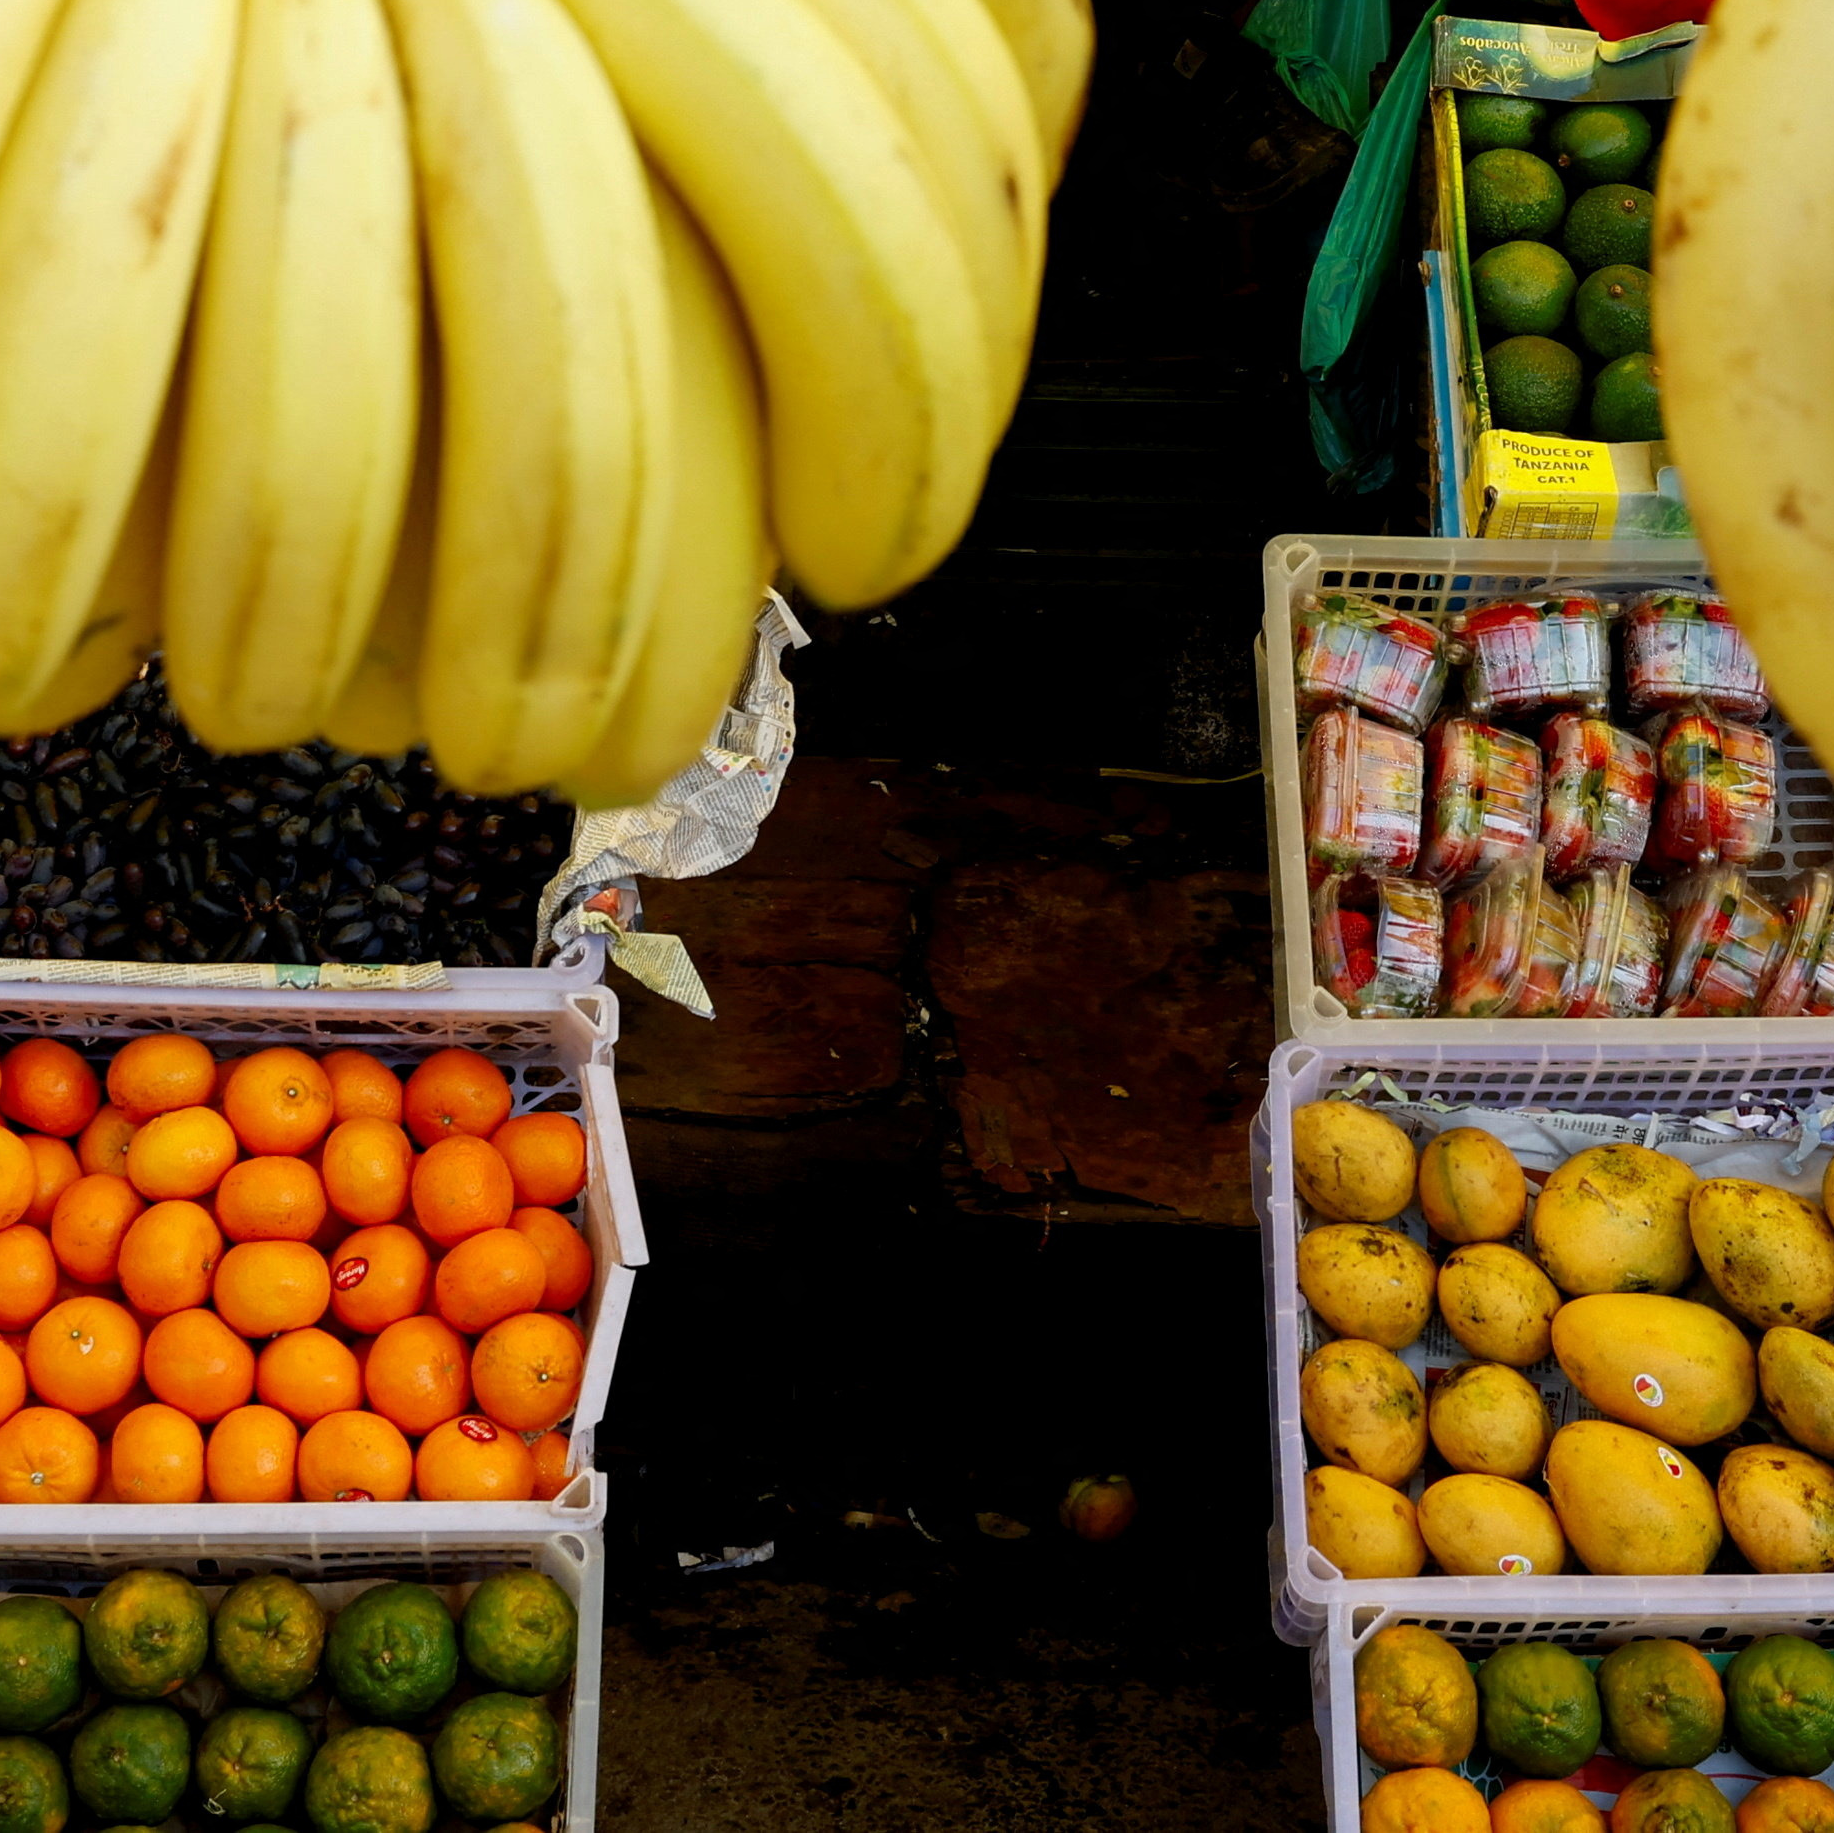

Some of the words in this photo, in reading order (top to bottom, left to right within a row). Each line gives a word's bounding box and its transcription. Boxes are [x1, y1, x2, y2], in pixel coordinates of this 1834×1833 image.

[1459, 36, 1531, 57] Avocados
[1502, 439, 1571, 458] PRODUCE
[1575, 450, 1595, 459] OF
[1513, 457, 1590, 471] TANZANIA
[1537, 476, 1576, 484] CAT.1
